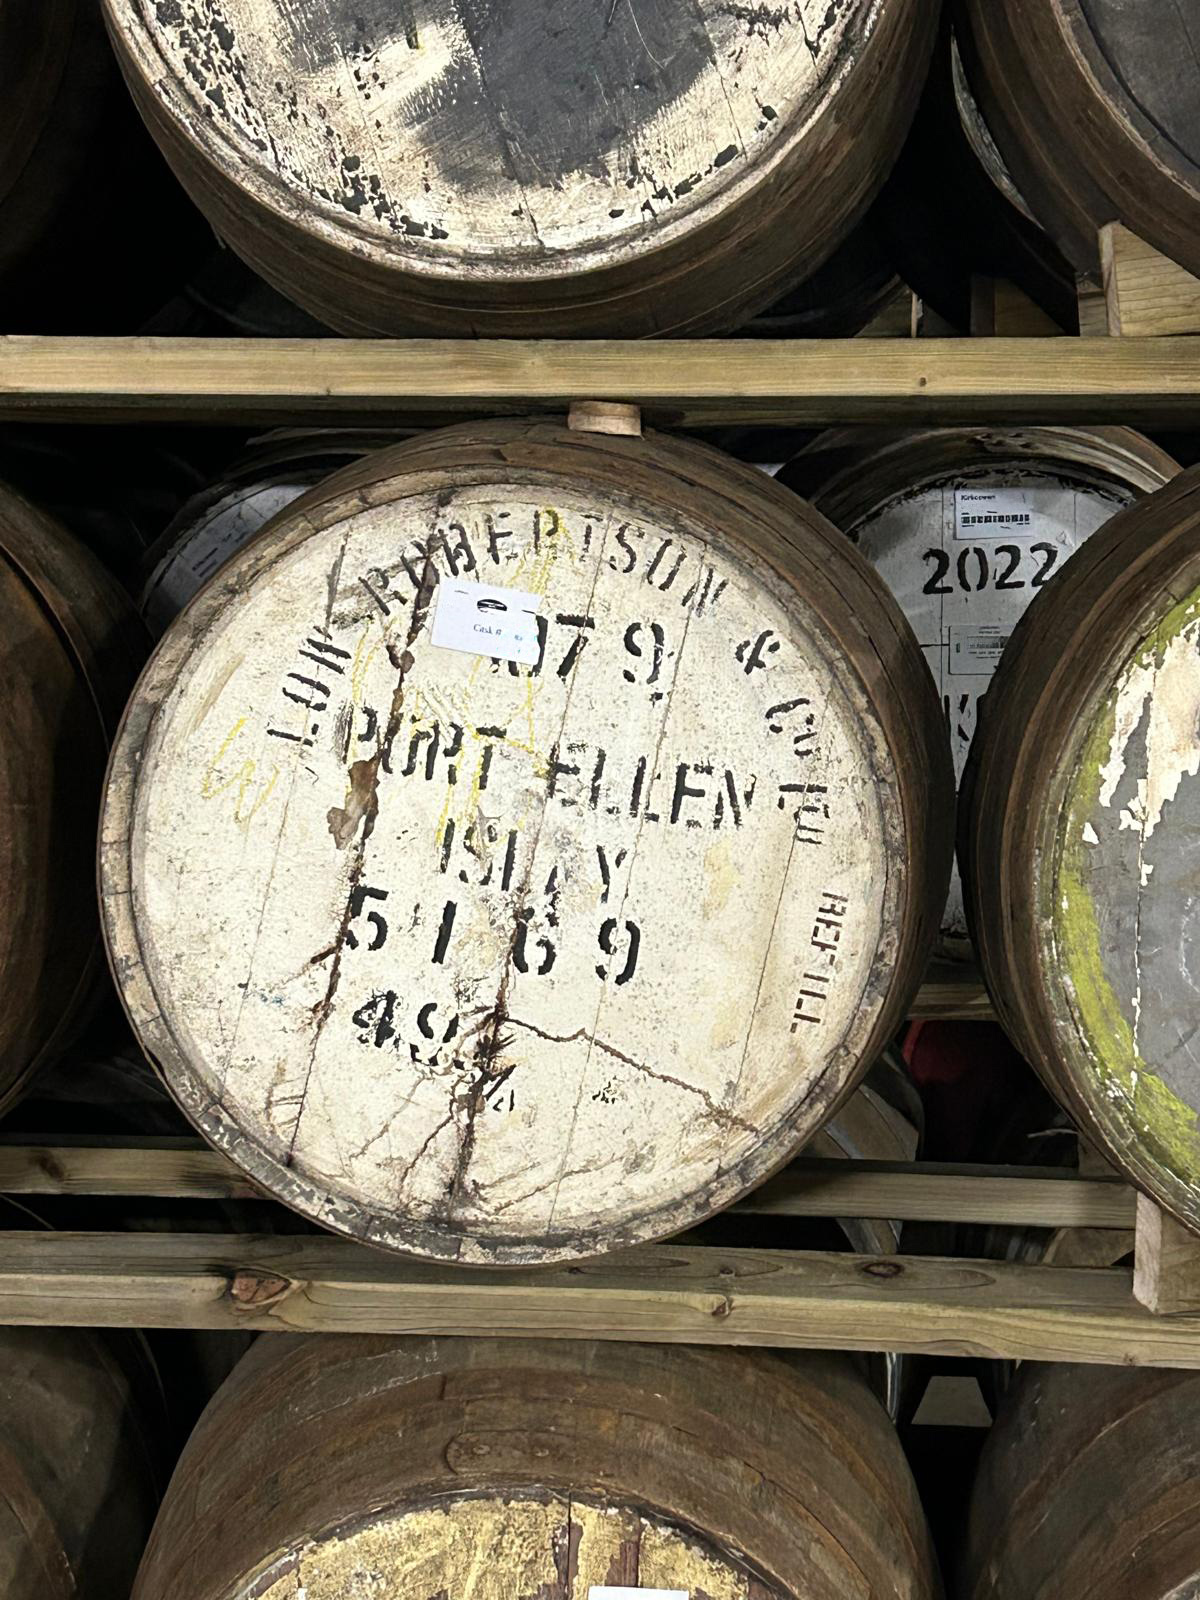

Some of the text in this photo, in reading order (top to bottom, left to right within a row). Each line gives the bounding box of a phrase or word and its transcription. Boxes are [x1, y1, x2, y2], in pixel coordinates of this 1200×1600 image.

[922, 543, 1058, 595] 2022
[473, 623, 492, 635] Cask
[735, 630, 780, 675] &
[340, 706, 758, 831] PORT ELLEN
[440, 818, 629, 928] ISLAY
[345, 885, 641, 986] 5169
[790, 892, 848, 1034] REFILL
